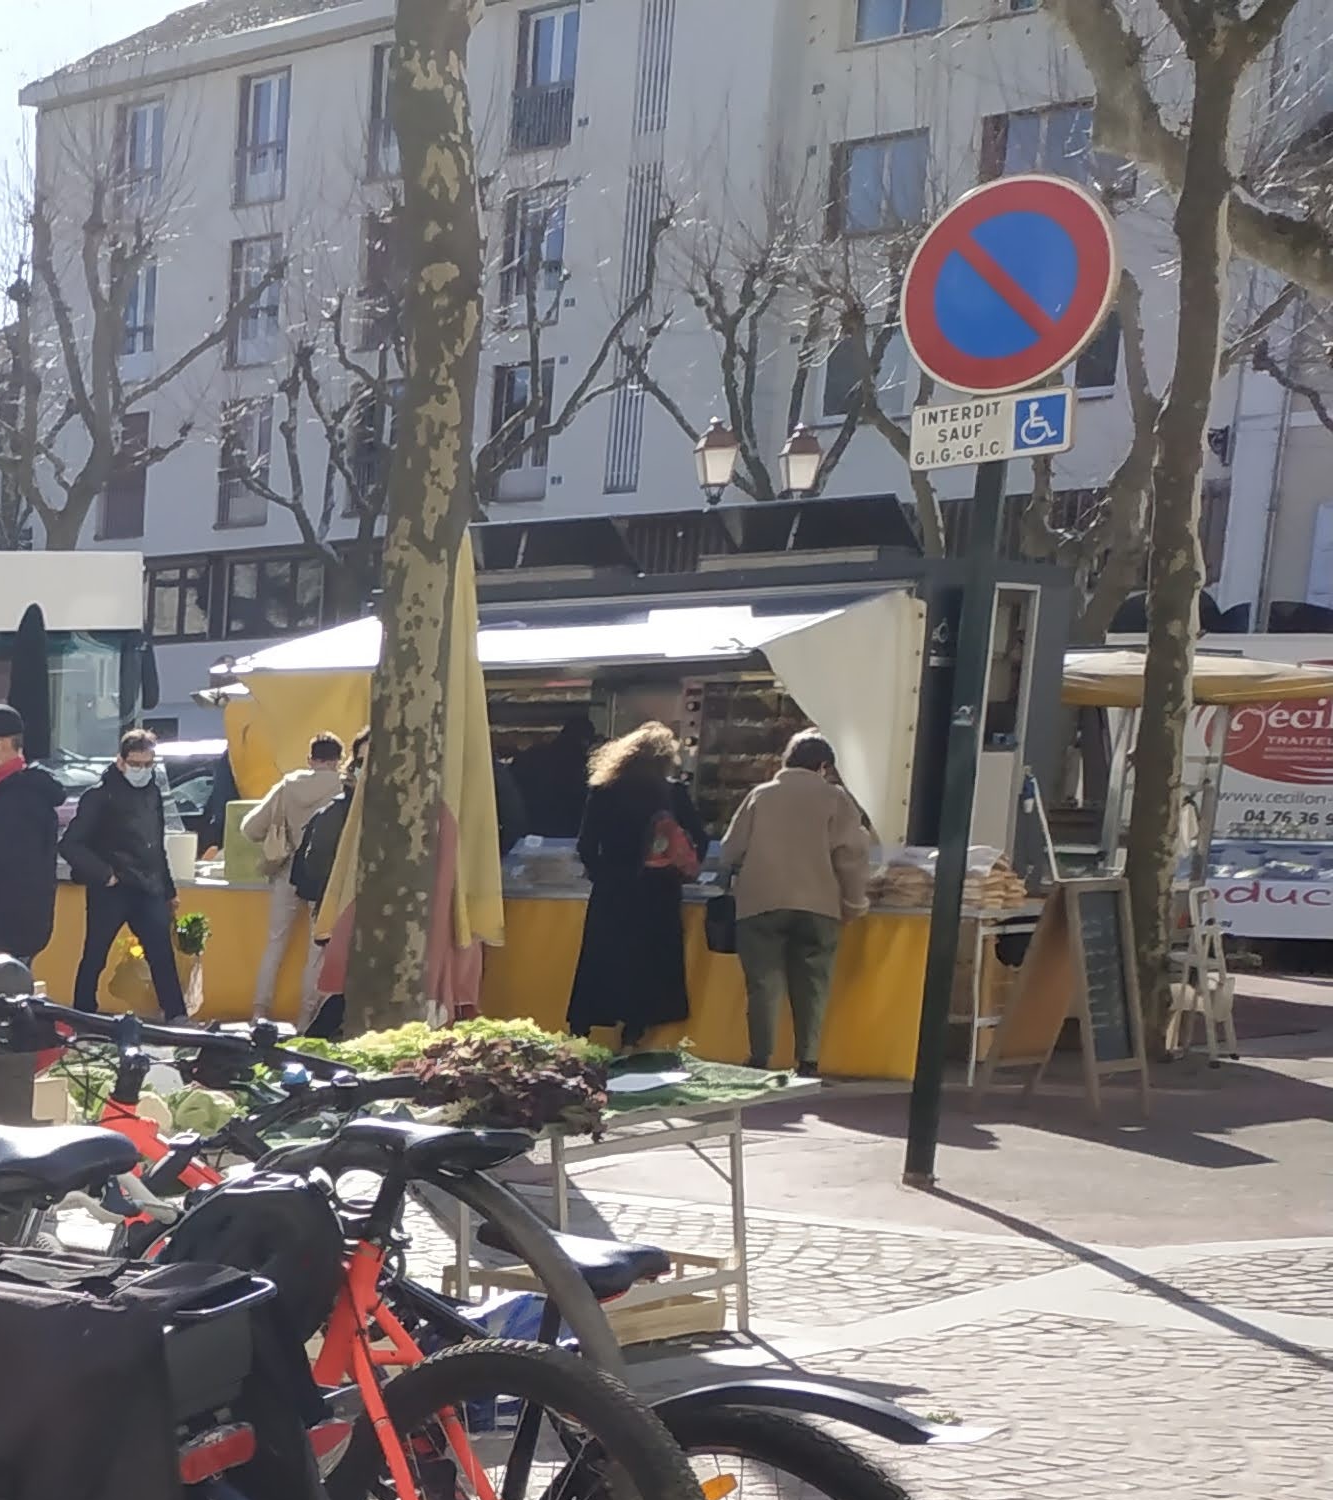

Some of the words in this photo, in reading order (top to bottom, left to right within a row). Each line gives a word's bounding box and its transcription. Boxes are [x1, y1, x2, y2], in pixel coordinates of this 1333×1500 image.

[922, 401, 1000, 427] INTERDIT
[938, 423, 983, 443] SAUF
[915, 441, 1004, 466] G.I.G.-G.I.C.
[1244, 809, 1266, 823] 04
[1271, 810, 1292, 825] 76
[1298, 811, 1320, 826] 36
